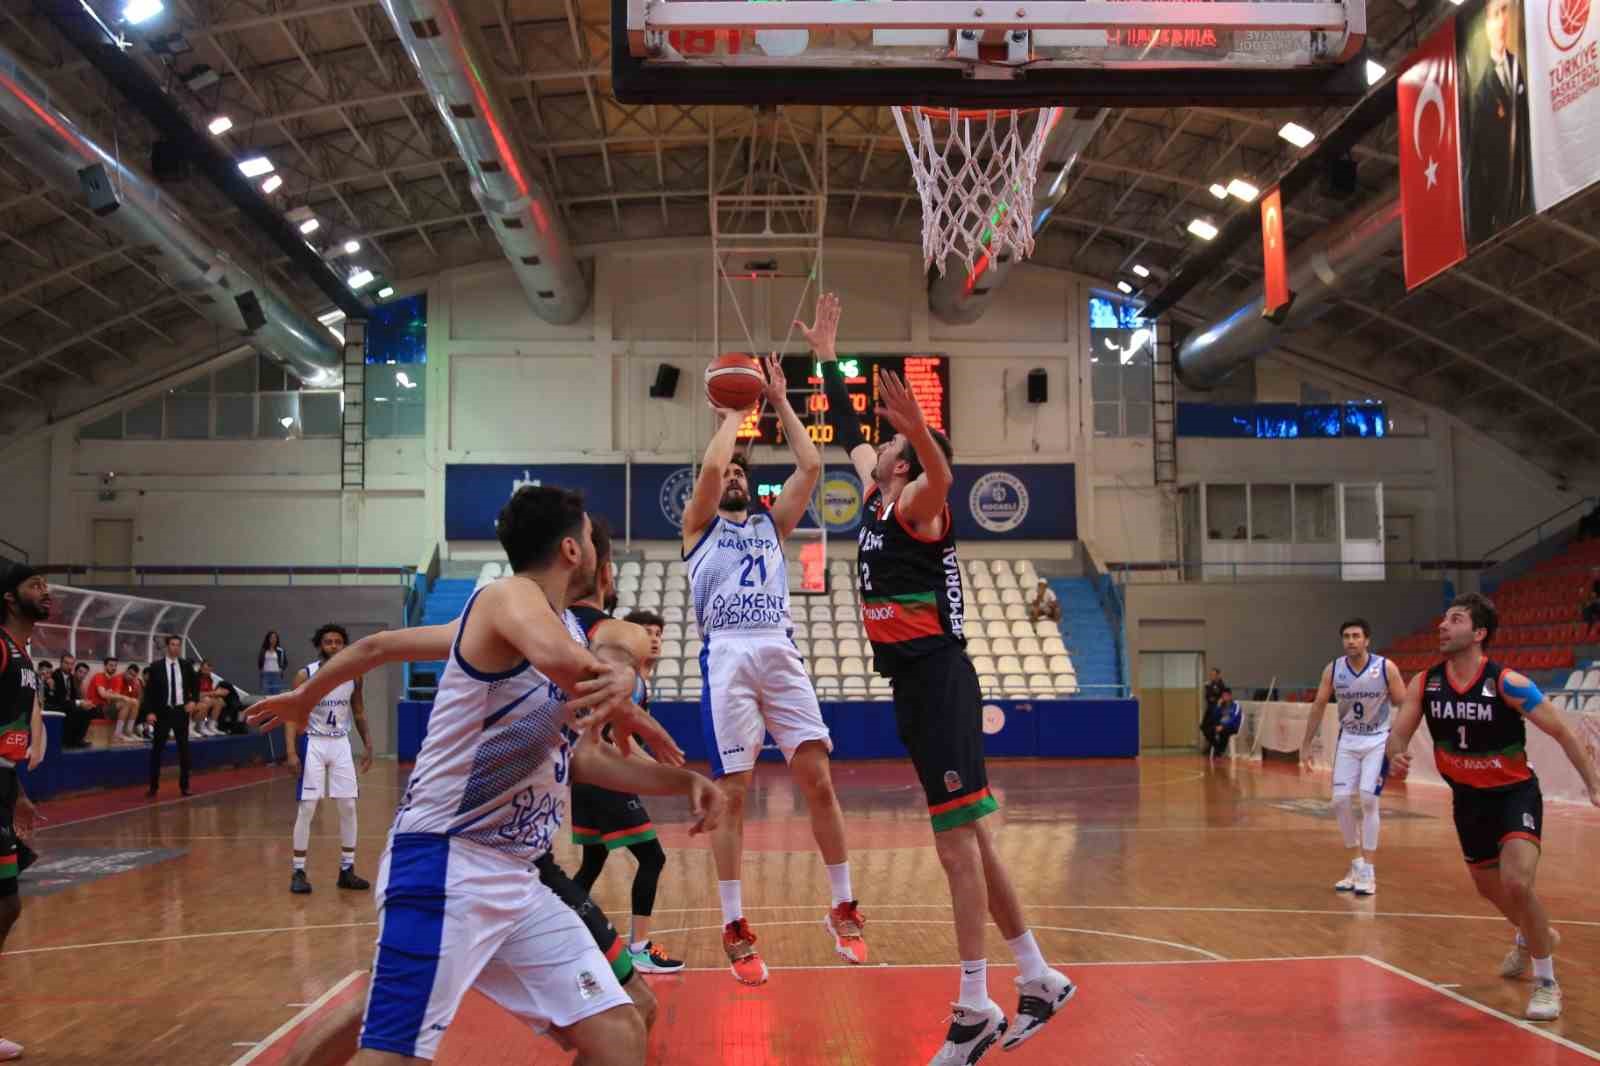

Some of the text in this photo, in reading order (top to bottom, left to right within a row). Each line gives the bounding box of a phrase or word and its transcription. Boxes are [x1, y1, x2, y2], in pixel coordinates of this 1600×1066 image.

[740, 553, 767, 588] 21
[742, 593, 784, 610] KENT
[326, 710, 337, 728] 4
[1353, 702, 1364, 720] 9
[1430, 701, 1493, 721] HAREM
[1457, 725, 1468, 749] 1
